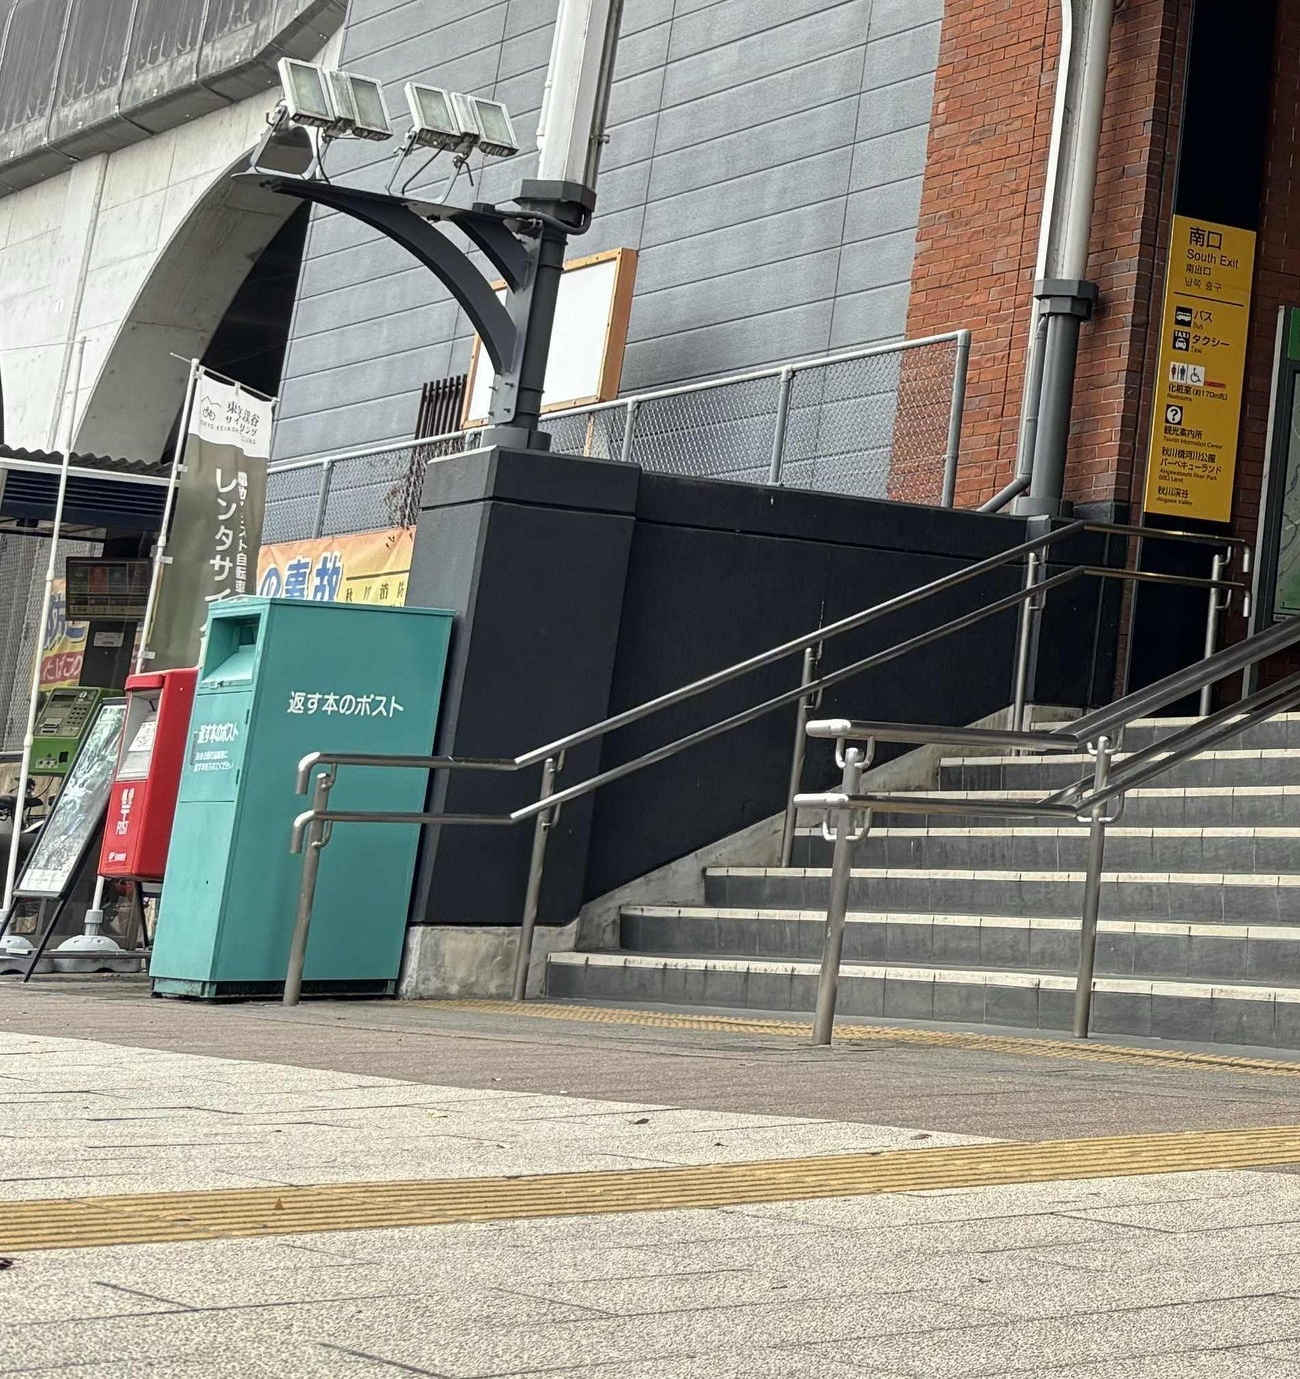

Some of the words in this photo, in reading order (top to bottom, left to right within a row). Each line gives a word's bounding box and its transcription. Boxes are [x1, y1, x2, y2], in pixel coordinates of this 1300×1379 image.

[1190, 227, 1222, 250] 南口
[1187, 249, 1216, 264] South
[1220, 255, 1239, 269] Exit
[1193, 310, 1213, 322] バス
[1192, 334, 1230, 347] タクシー
[1160, 458, 1221, 475] バーベキューランド
[287, 691, 404, 717] 返す本のポスト
